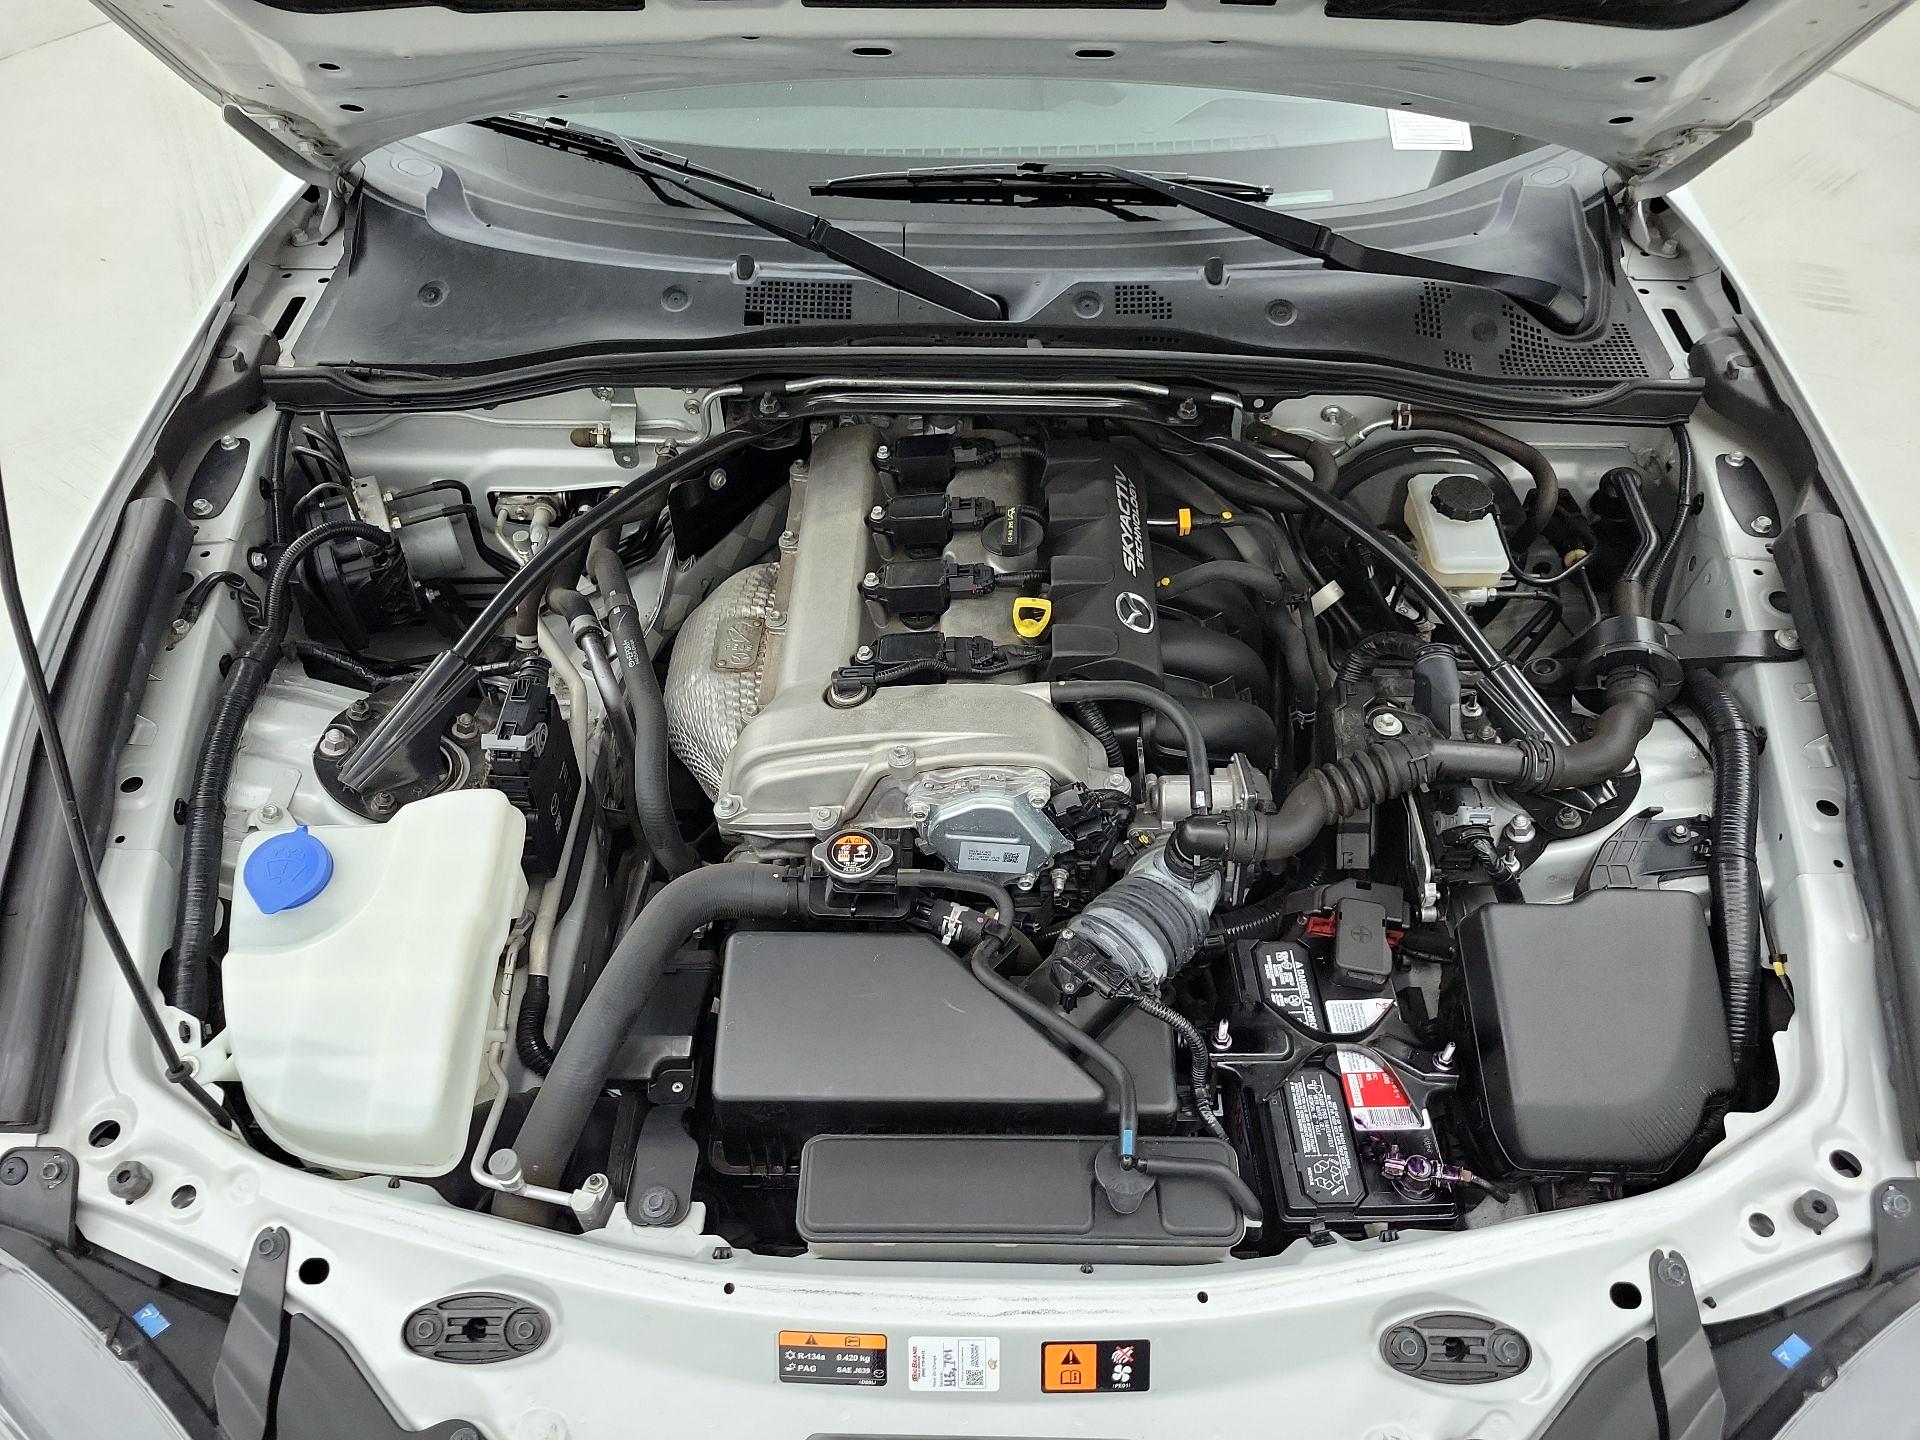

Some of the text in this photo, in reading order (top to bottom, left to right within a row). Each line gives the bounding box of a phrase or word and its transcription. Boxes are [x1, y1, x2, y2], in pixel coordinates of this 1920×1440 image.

[1114, 464, 1137, 577] SKYACTIV
[1128, 478, 1145, 570] TECHNOLOGY
[797, 1352, 871, 1364] R-134a 0.420 kg
[797, 1364, 871, 1374] PAG SAE J639
